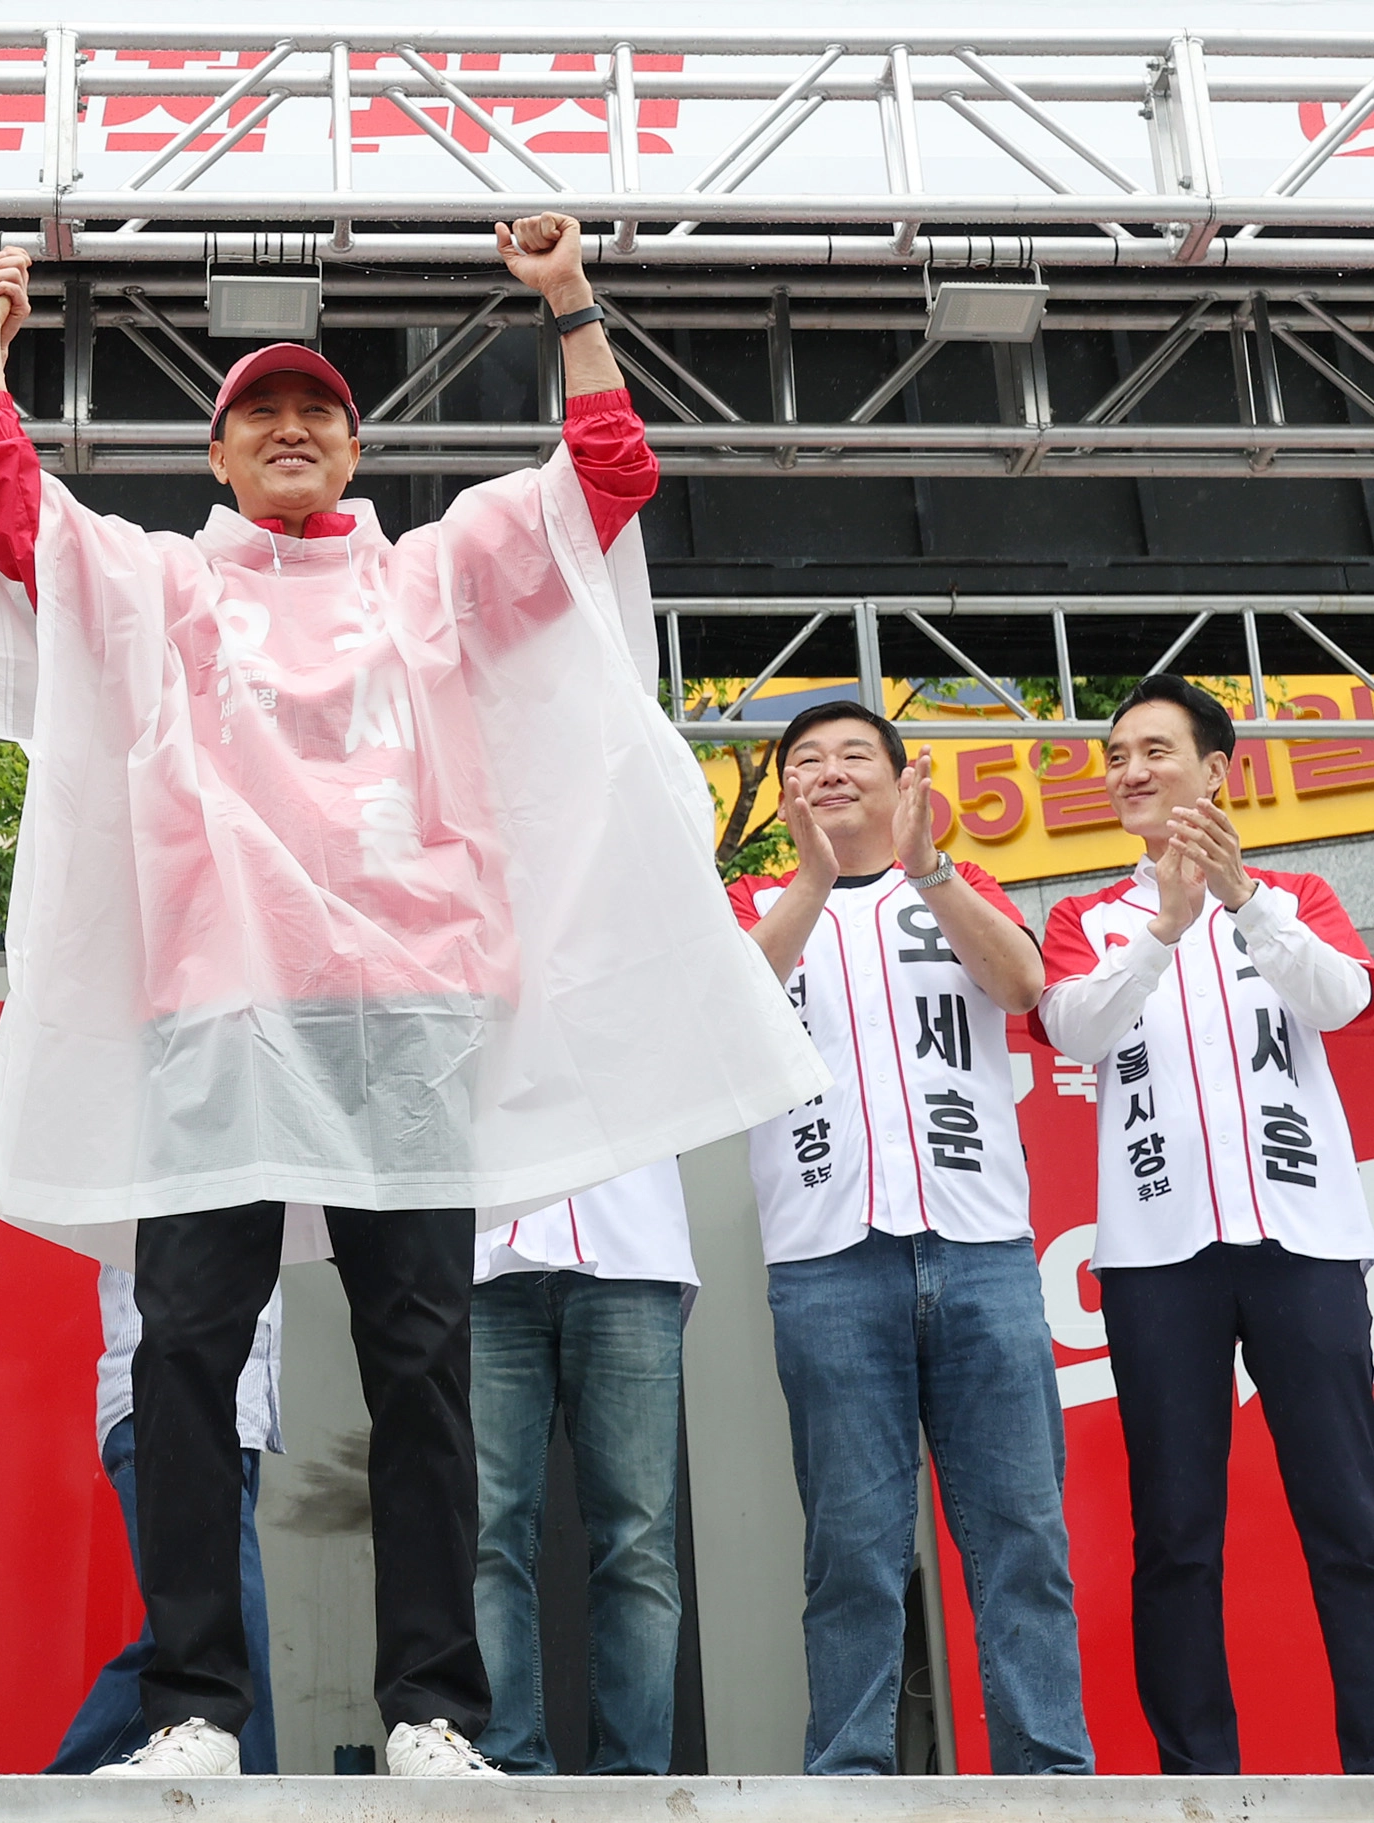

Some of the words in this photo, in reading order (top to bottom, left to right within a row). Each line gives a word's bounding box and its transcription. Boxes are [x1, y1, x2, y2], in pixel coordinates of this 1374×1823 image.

[897, 904, 983, 1173] 오세훈
[1116, 1012, 1167, 1179] 울시장
[800, 1162, 832, 1188] 후보
[1137, 1176, 1172, 1202] 후보
